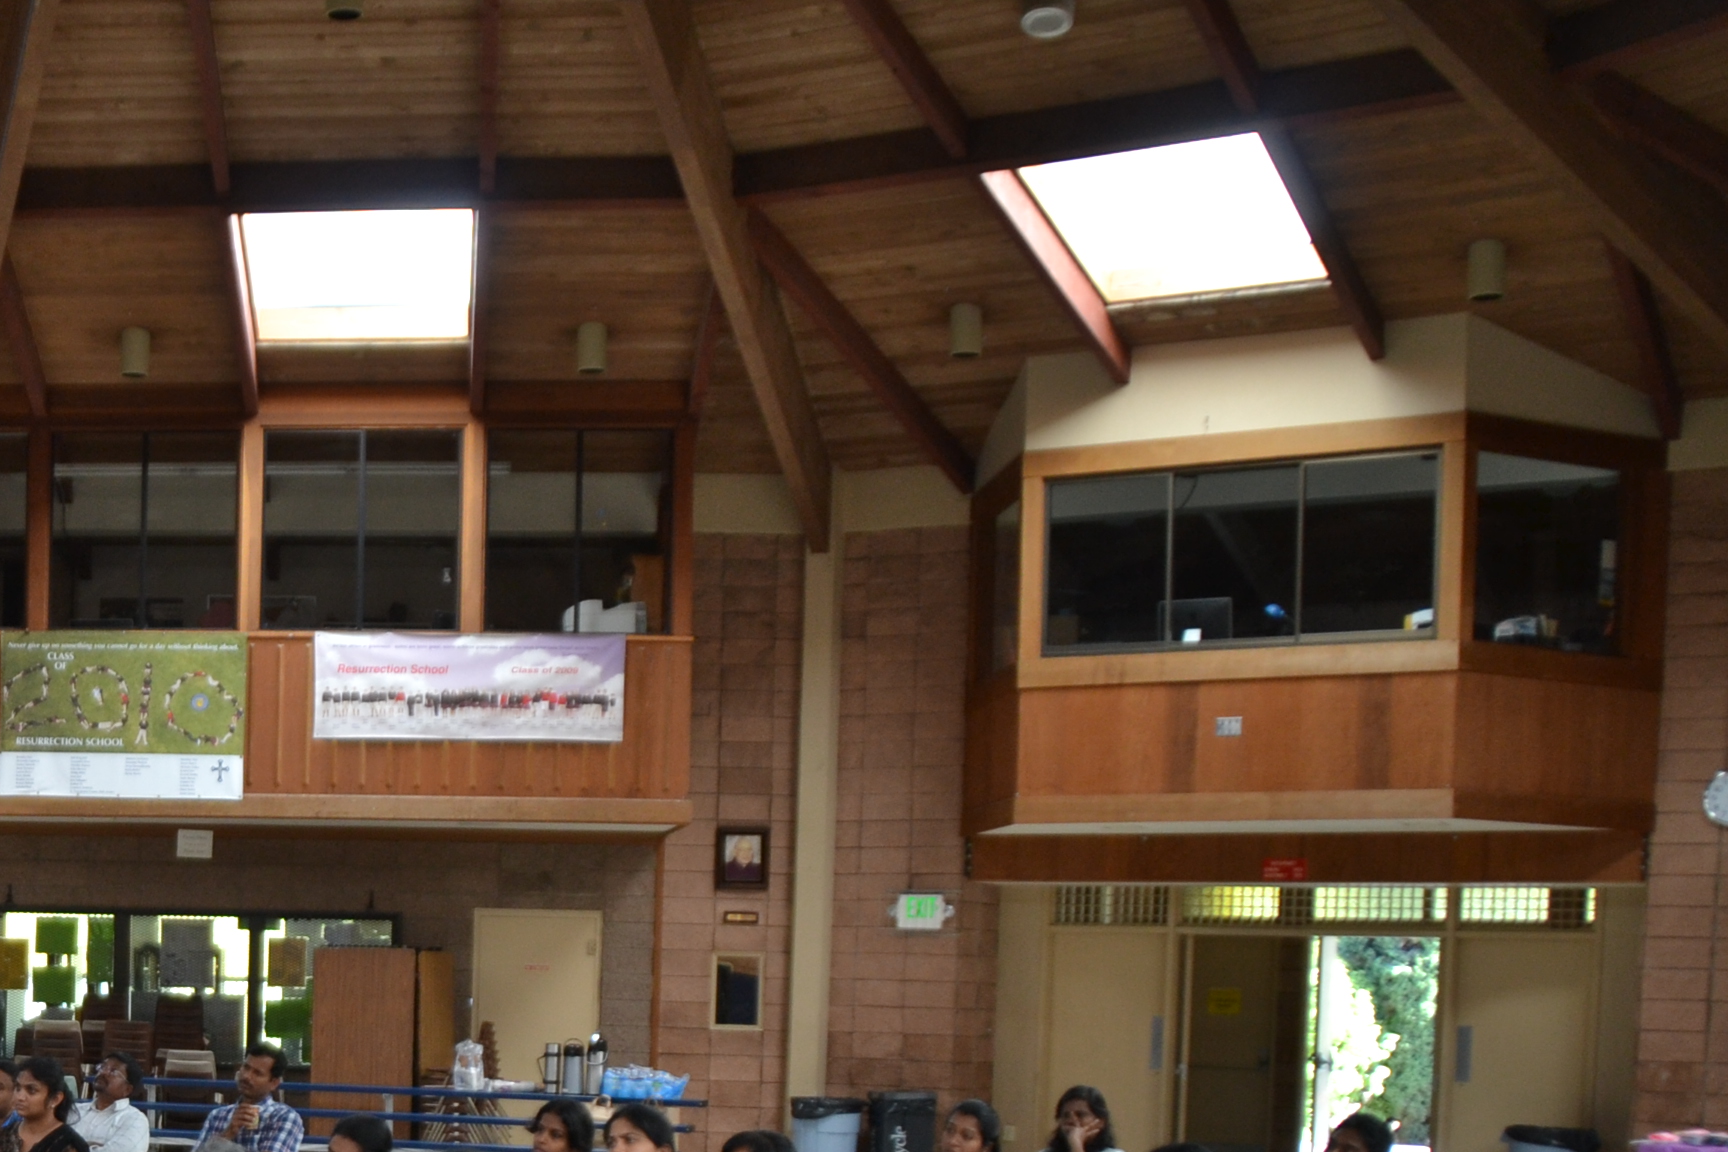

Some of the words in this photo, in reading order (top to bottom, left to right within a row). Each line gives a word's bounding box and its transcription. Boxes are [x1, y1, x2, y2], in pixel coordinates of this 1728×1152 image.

[47, 651, 75, 661] CLASS
[54, 661, 68, 670] OF
[337, 663, 407, 675] Resurrection
[410, 664, 449, 675] School
[511, 666, 540, 675] Class
[542, 666, 552, 675] of
[15, 737, 83, 747] RESURRECTION
[85, 738, 124, 748] SCHOOL
[907, 896, 938, 918] EXIT
